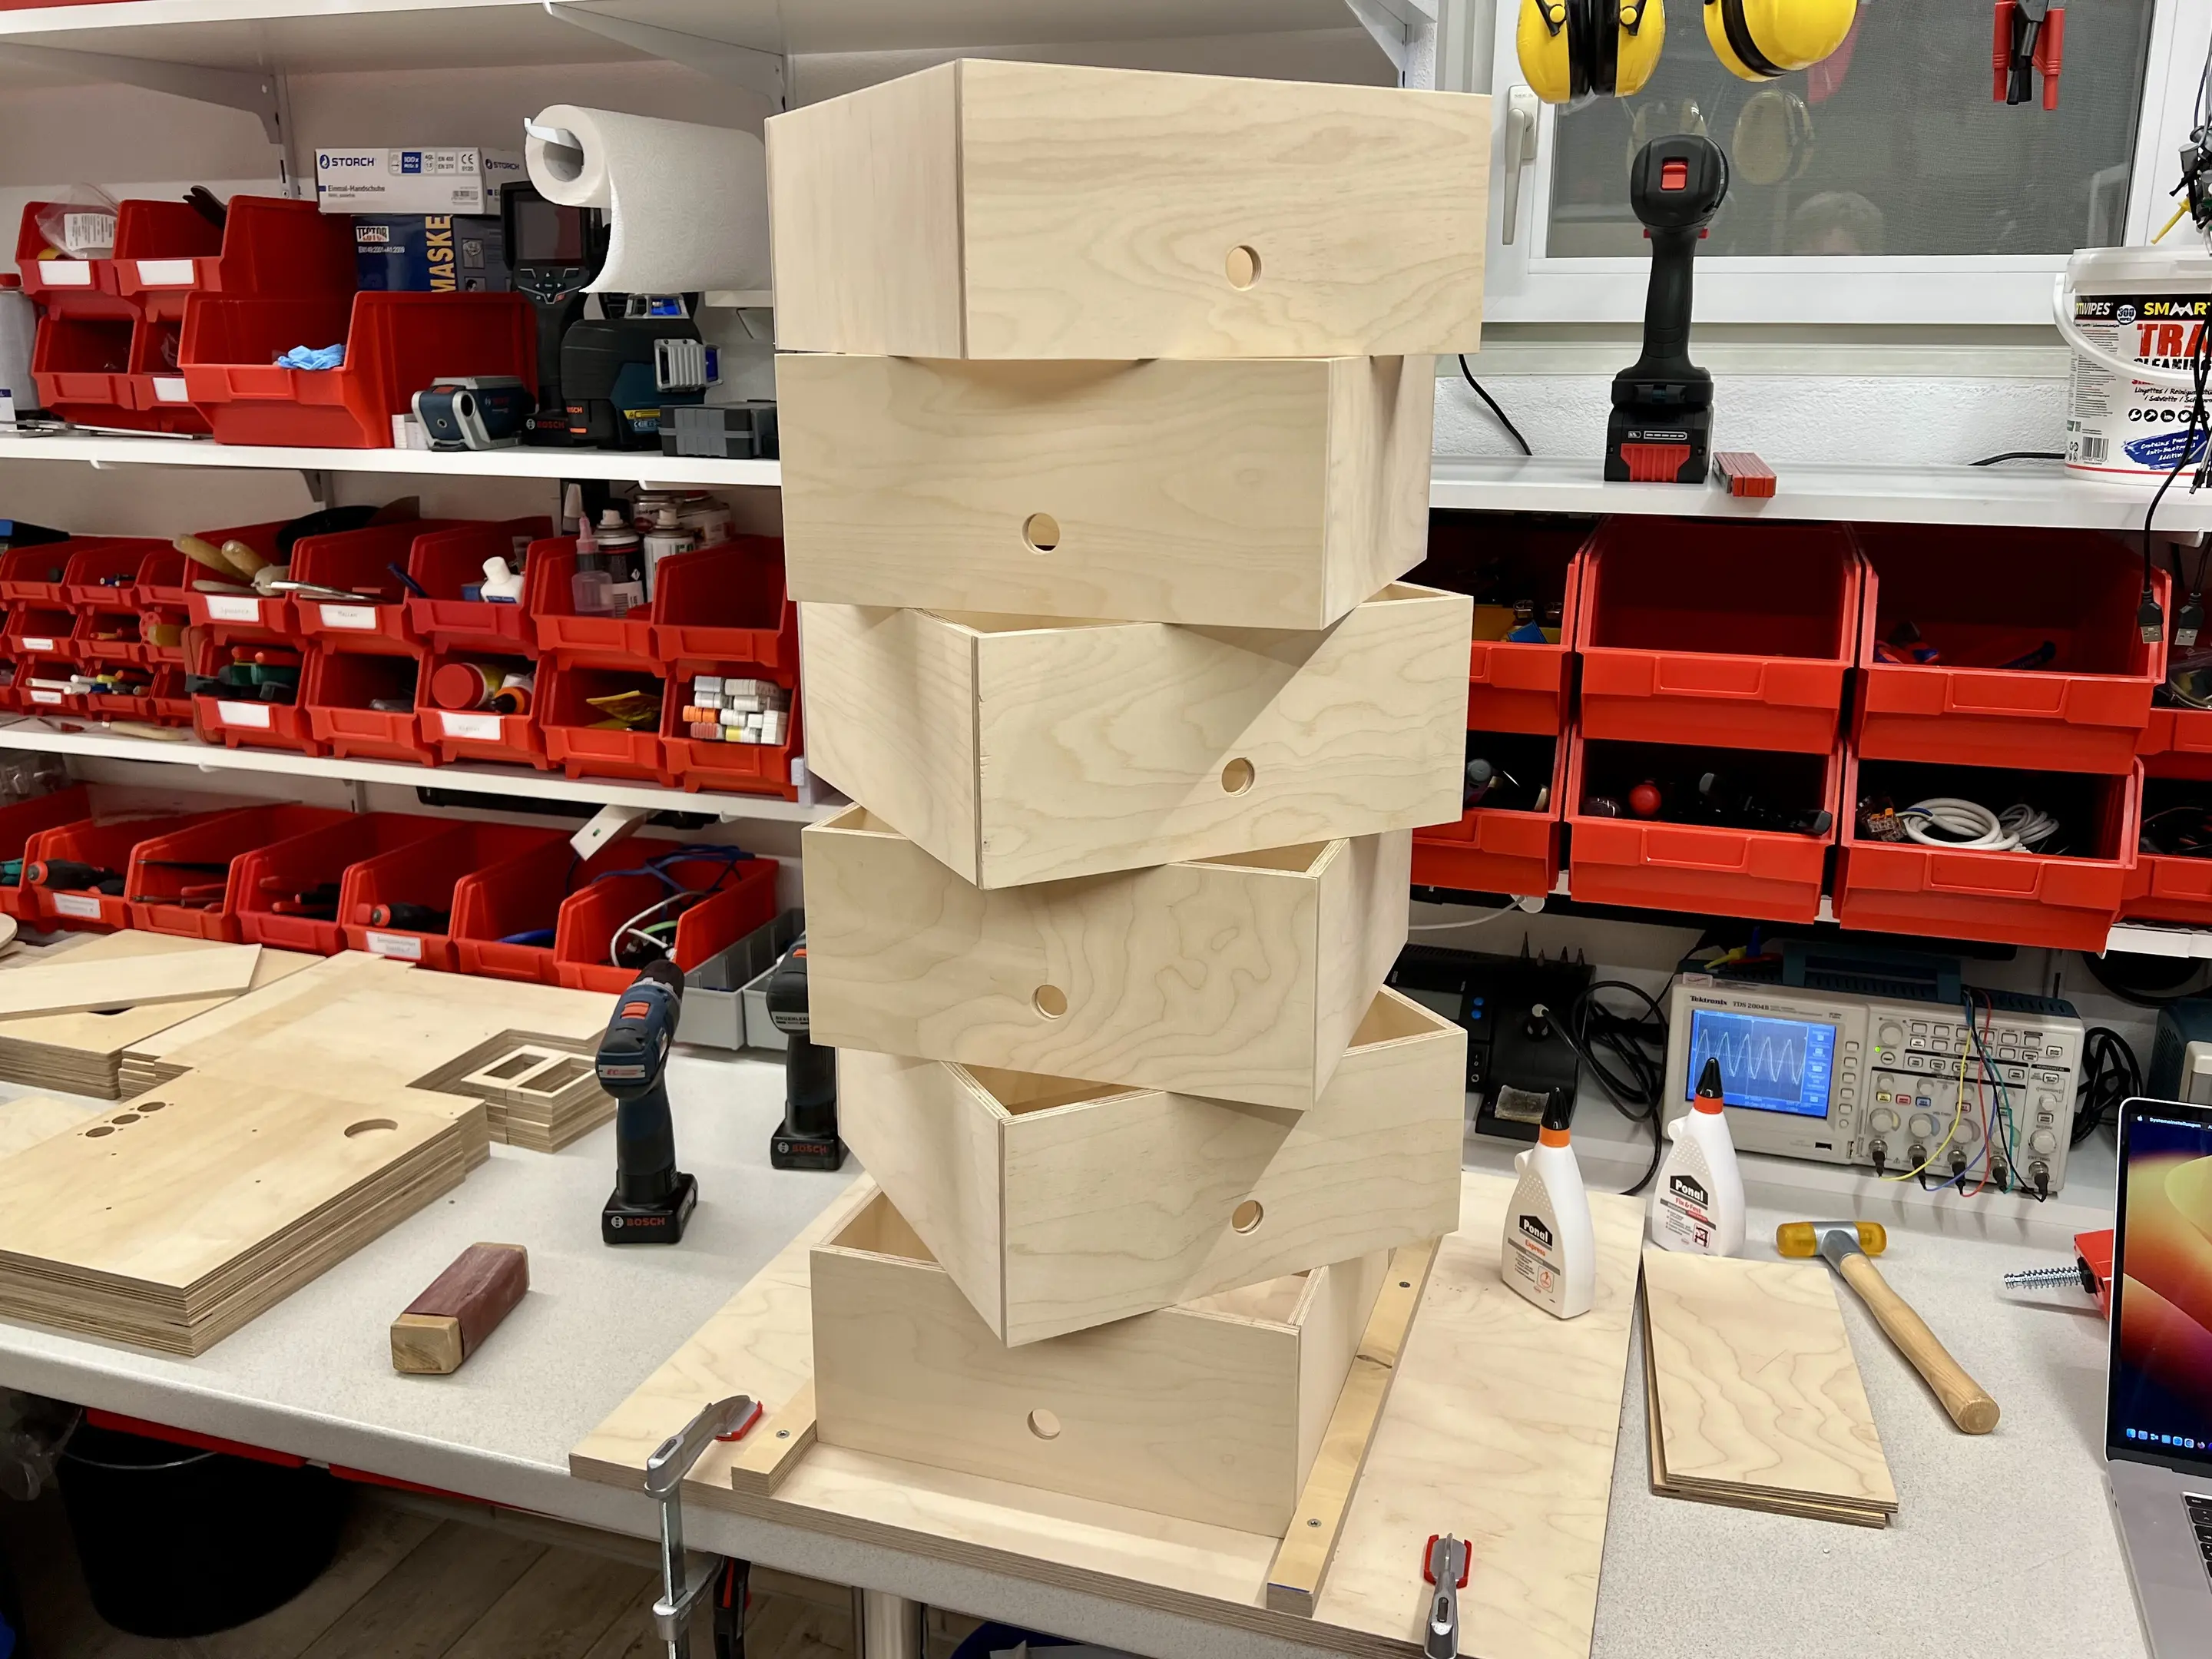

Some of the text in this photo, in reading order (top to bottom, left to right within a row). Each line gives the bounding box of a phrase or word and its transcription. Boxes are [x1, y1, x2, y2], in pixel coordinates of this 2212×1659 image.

[331, 157, 375, 167] STORCH
[493, 161, 520, 171] STORCH
[425, 216, 456, 292] MASKE
[2118, 308, 2135, 317] 300
[536, 420, 565, 429] BOSCH
[1689, 995, 1728, 1006] Tektronix
[792, 1144, 827, 1155] BOSCH
[1675, 1178, 1704, 1202] Ponal
[626, 1217, 665, 1227] BOSCH
[1523, 1218, 1548, 1243] Ponal
